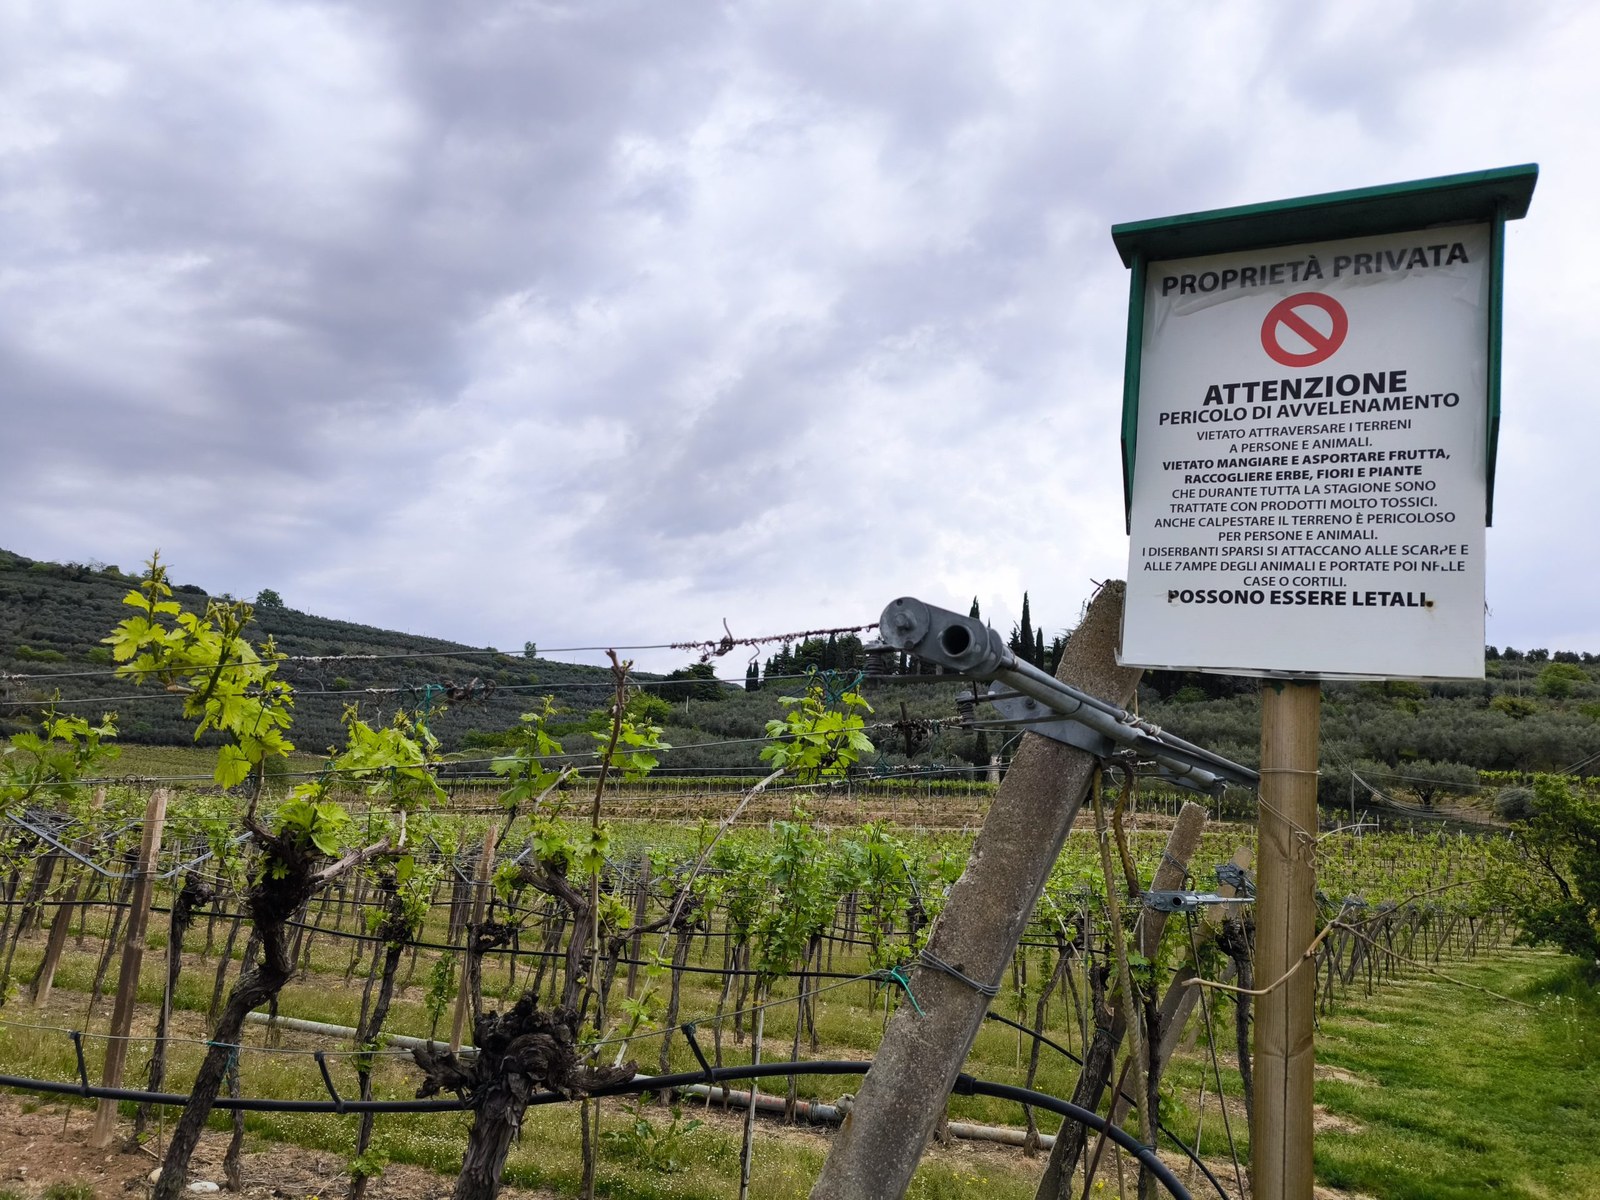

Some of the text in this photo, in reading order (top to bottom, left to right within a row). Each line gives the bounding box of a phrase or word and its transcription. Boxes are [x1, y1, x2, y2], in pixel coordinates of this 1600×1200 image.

[1162, 242, 1469, 297] PROPRIETÀ PRIVATA
[1203, 370, 1407, 406] ATTENZIONE
[1159, 392, 1460, 426] PERICOLO DI AVVELENAMENTO
[1197, 419, 1411, 440] VIETATO ATTRAVERSARE I TERRENI
[1229, 437, 1373, 453] A PERSONE E ANIMALI.
[1163, 448, 1450, 471] VIETATO MANGIARE E ASPORTARE FRUTTA,
[1185, 465, 1422, 484] RACCOGLIERE ERBE, FIORI E PIANTE
[1172, 480, 1437, 499] CHE DURANTE TUTTA LA STAGIONE SONO
[1170, 496, 1438, 513] TRATTATE CON PRODOTTI MOLTO TOSSICI.
[1154, 512, 1456, 528] ANCHE CALPESTARE IL TERRENO È PERICOLOSO
[1218, 530, 1378, 542] PER PERSONE E ANIMALI.
[1142, 547, 1146, 557] I
[1149, 547, 1218, 557] DISERBANTI
[1221, 546, 1264, 557] SPARSI
[1267, 546, 1278, 556] SI
[1281, 545, 1361, 556] ATTACCANO
[1365, 545, 1398, 556] ALLE
[1461, 545, 1469, 555] E
[1144, 561, 1172, 571] ALLE
[1220, 561, 1257, 571] DEGLI
[1260, 561, 1315, 572] ANIMALI
[1319, 561, 1326, 571] E
[1330, 561, 1390, 572] PORTATE
[1393, 561, 1417, 572] POI
[1243, 576, 1347, 587] CASE O CORTILI.
[1167, 589, 1265, 605] POSSONO
[1270, 590, 1347, 605] ESSERE
